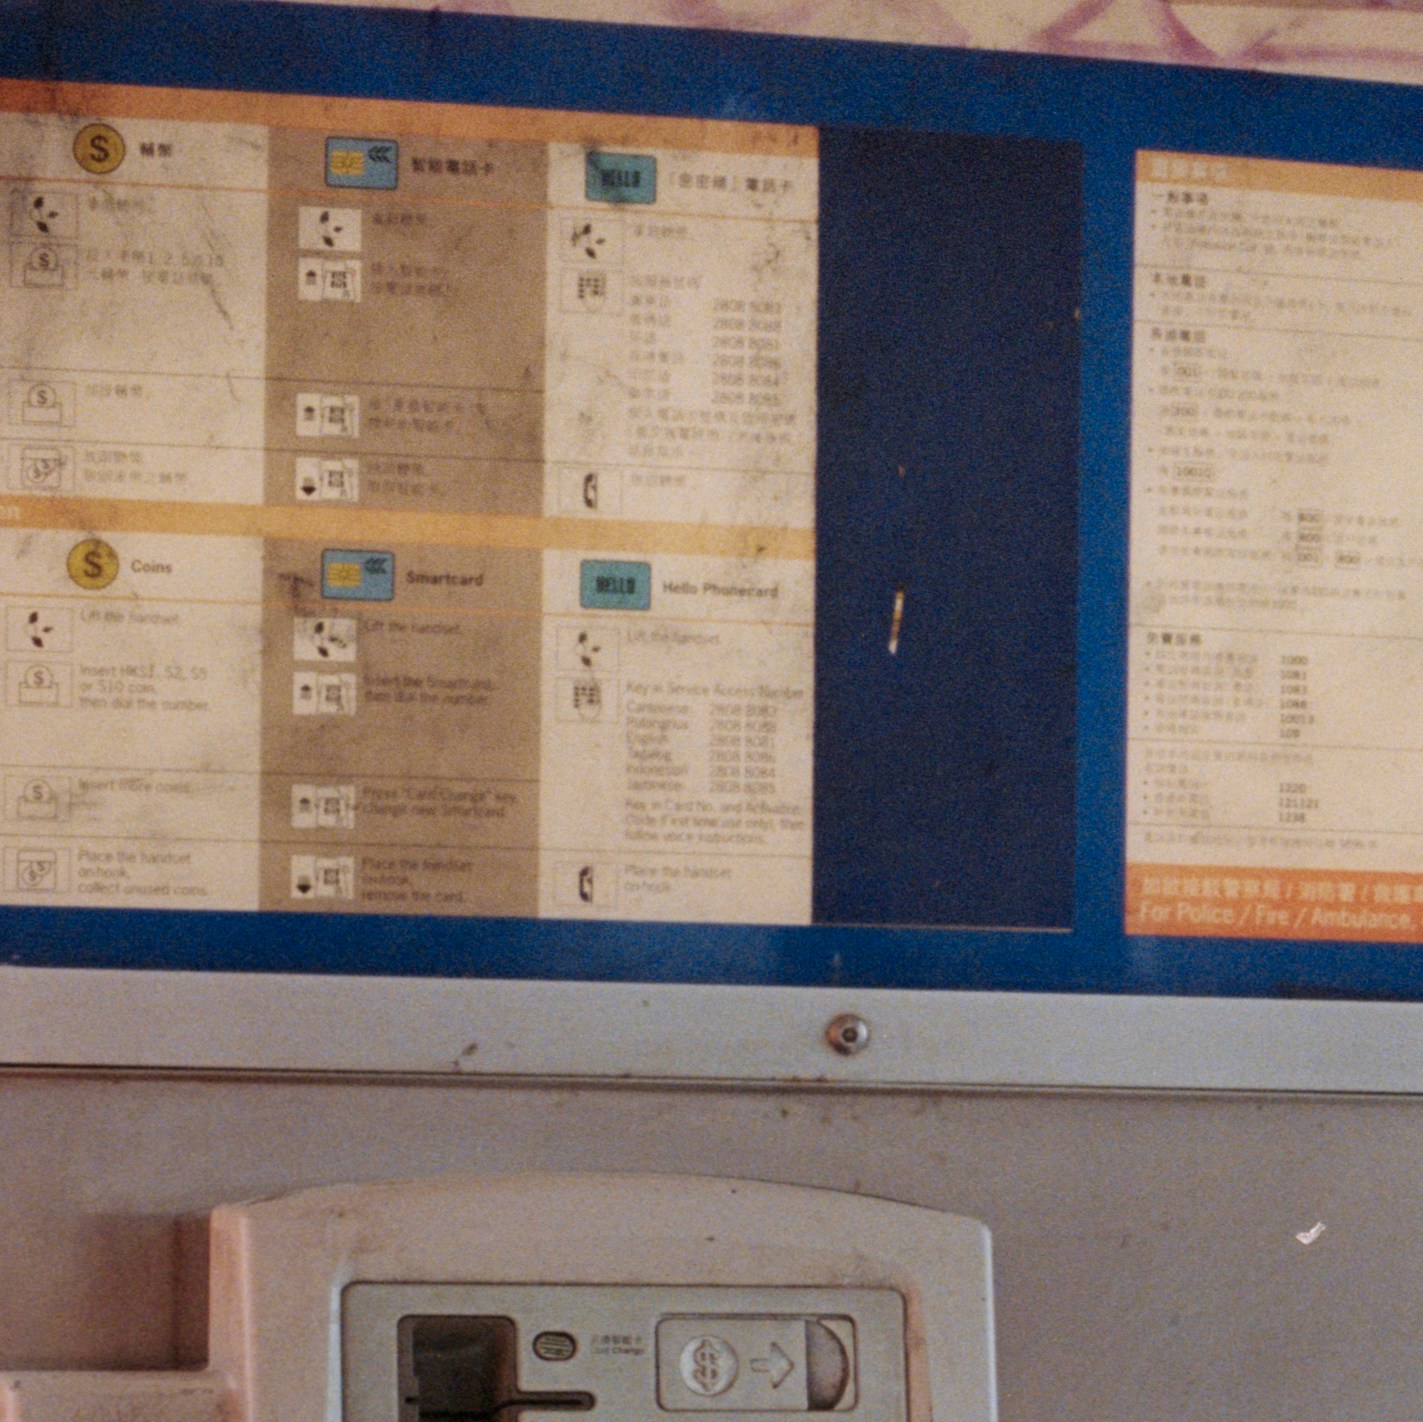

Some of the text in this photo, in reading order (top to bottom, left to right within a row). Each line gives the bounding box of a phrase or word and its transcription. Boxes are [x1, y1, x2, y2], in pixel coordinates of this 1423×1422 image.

[131, 558, 172, 575] Coins
[406, 570, 484, 587] Smartcard
[663, 580, 779, 600] Hello Phonecard
[1140, 902, 1171, 923] For
[1177, 902, 1235, 925] Police
[1255, 904, 1292, 927] Fire
